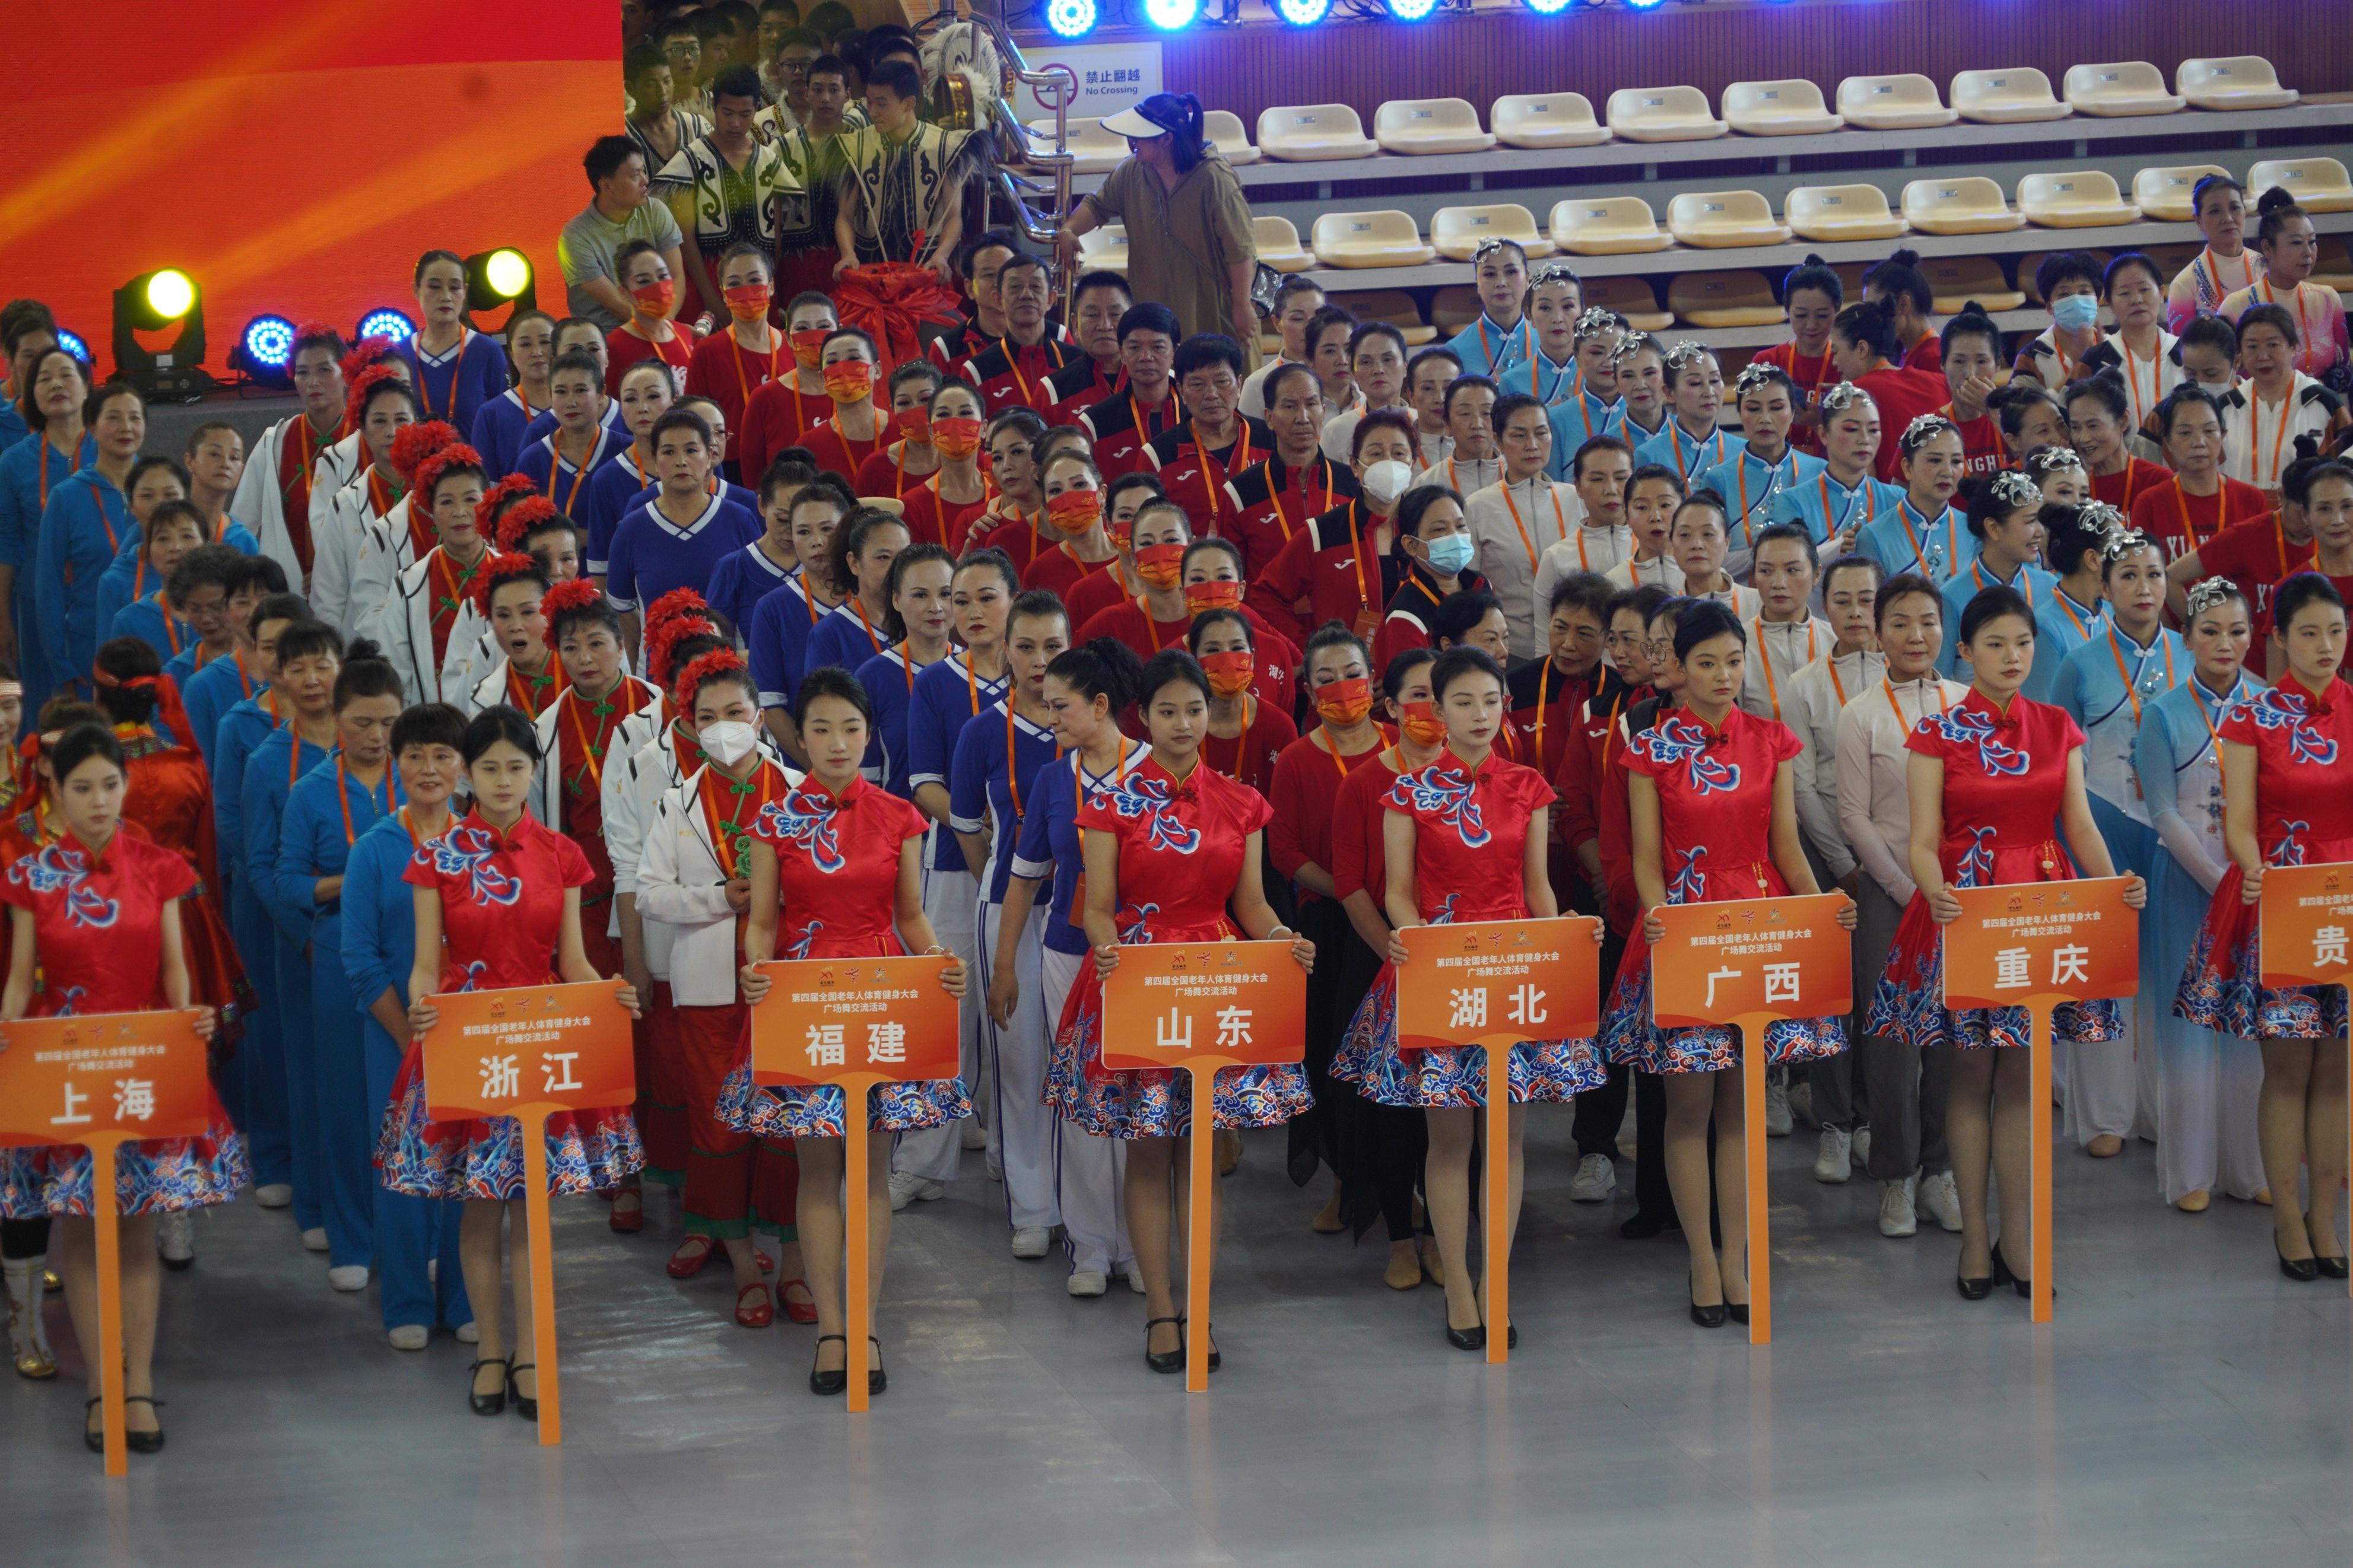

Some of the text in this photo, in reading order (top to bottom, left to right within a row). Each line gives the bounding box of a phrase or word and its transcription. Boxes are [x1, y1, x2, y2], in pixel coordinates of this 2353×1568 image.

[1085, 68, 1140, 84] 禁止翻越
[1086, 85, 1138, 96] No Crossing
[1982, 911, 2101, 928] 第四届全国老年人体育健身大会
[1691, 929, 1811, 946] 第四届全国老年人体育健身大会
[2012, 925, 2071, 937] 广场舞交流活动
[1721, 943, 1782, 955] 广场舞交流活动
[2312, 925, 2349, 967] 贵
[1437, 951, 1559, 968] 第四届全国老年人体育健身大会
[1995, 943, 2088, 988] 重庆
[1145, 973, 1268, 986] 第四届全国老年人体育健身大会
[1468, 966, 1529, 977] 广场舞交流活动
[1176, 987, 1237, 996] 广场舞交流活动
[1705, 962, 1800, 1007] 广西
[792, 989, 918, 1003] 第四届全国老年人体育健身大会
[824, 1003, 887, 1013] 广场舞交流活动
[1449, 984, 1547, 1028] 湖北
[463, 1016, 590, 1036] 第四届全国老年人体育健身大会
[1157, 1005, 1252, 1048] 山东
[496, 1031, 560, 1045] 广场舞交流活动
[805, 1022, 906, 1066] 福建
[480, 1052, 582, 1098] 浙江
[50, 1079, 154, 1124] 上海
